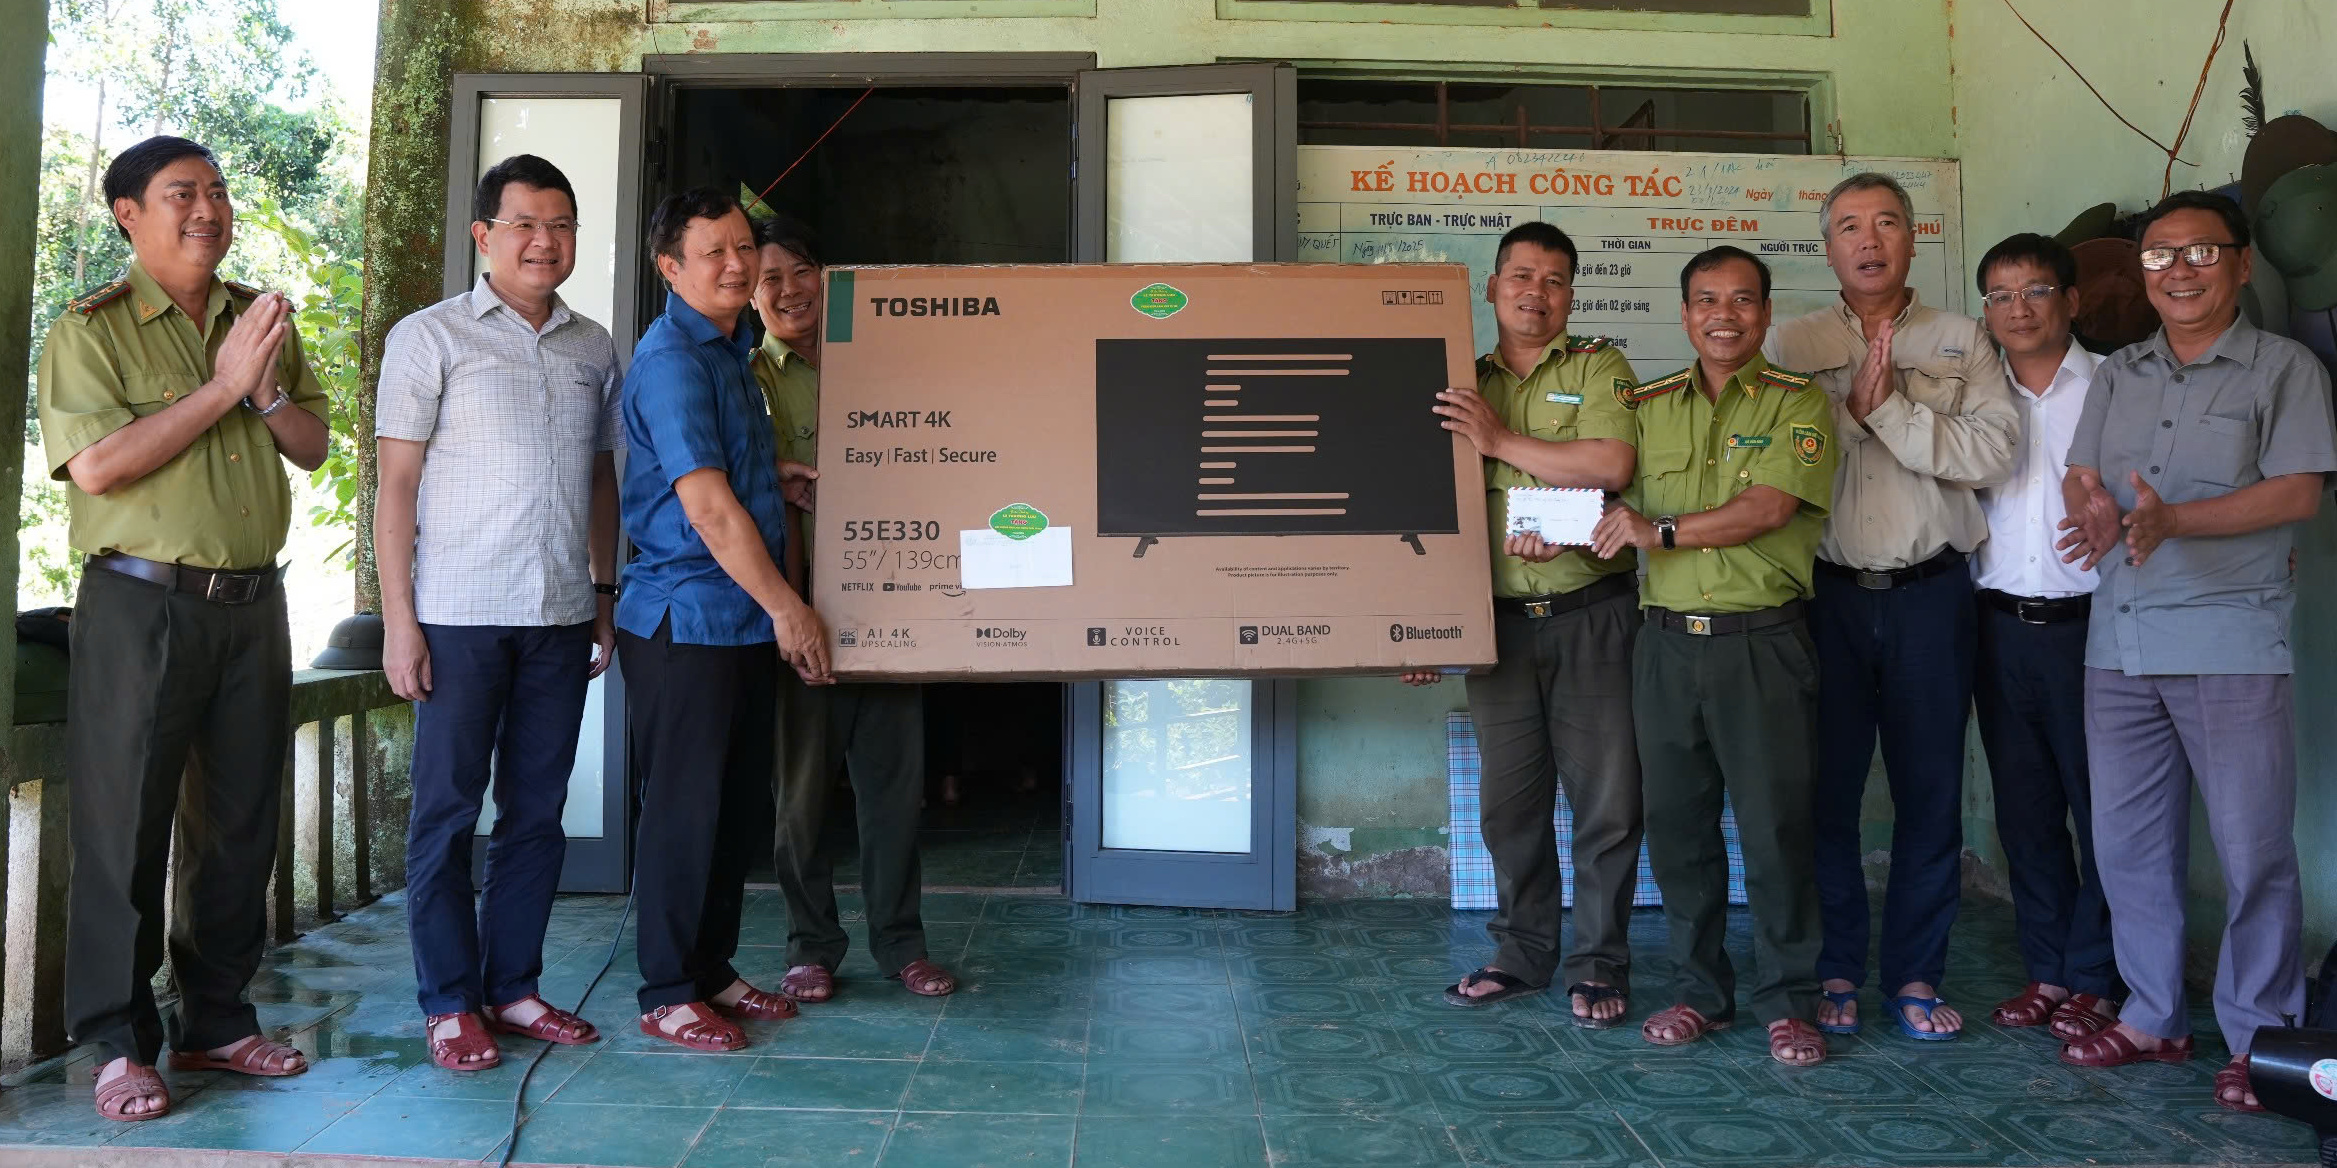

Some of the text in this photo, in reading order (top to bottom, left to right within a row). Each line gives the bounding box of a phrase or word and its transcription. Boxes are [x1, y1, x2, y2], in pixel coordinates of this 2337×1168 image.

[1350, 159, 1395, 192] KẾ
[1406, 171, 1518, 200] HOẠCH
[1529, 167, 1615, 196] CÔNG
[1623, 167, 1683, 197] TÁC
[1745, 188, 1775, 201] Ngày
[1369, 213, 1403, 230] TRỰC
[1407, 213, 1432, 227] BAN
[1443, 214, 1476, 230] TRỰC
[1480, 212, 1512, 229] NHẬT
[1647, 215, 1759, 234] TRỰC ĐÊM
[1601, 238, 1651, 250] THỜI GIAN
[1760, 241, 1819, 255] NGƯỜI TRỰC
[1582, 264, 1593, 277] giờ
[1595, 263, 1608, 275] đến
[1609, 264, 1618, 275] 23
[1621, 264, 1632, 277] giờ
[870, 296, 1001, 317] TOSHIBA
[1571, 299, 1650, 312] 23 giờ đến 02 giờ sáng
[847, 410, 952, 428] SMART 4K
[845, 447, 997, 467] Easy Fast Secure
[843, 520, 940, 541] 55E330
[841, 583, 874, 591] NETFLIX
[896, 583, 922, 591] YouTube
[929, 583, 954, 591] prime
[867, 628, 910, 638] AI 4K
[993, 628, 1027, 640] Dolby
[1125, 626, 1165, 635] VOICE
[1262, 625, 1331, 636] DUAL BAND
[1110, 637, 1181, 646] CONTROL
[1277, 636, 1318, 645] 2.4G+5G
